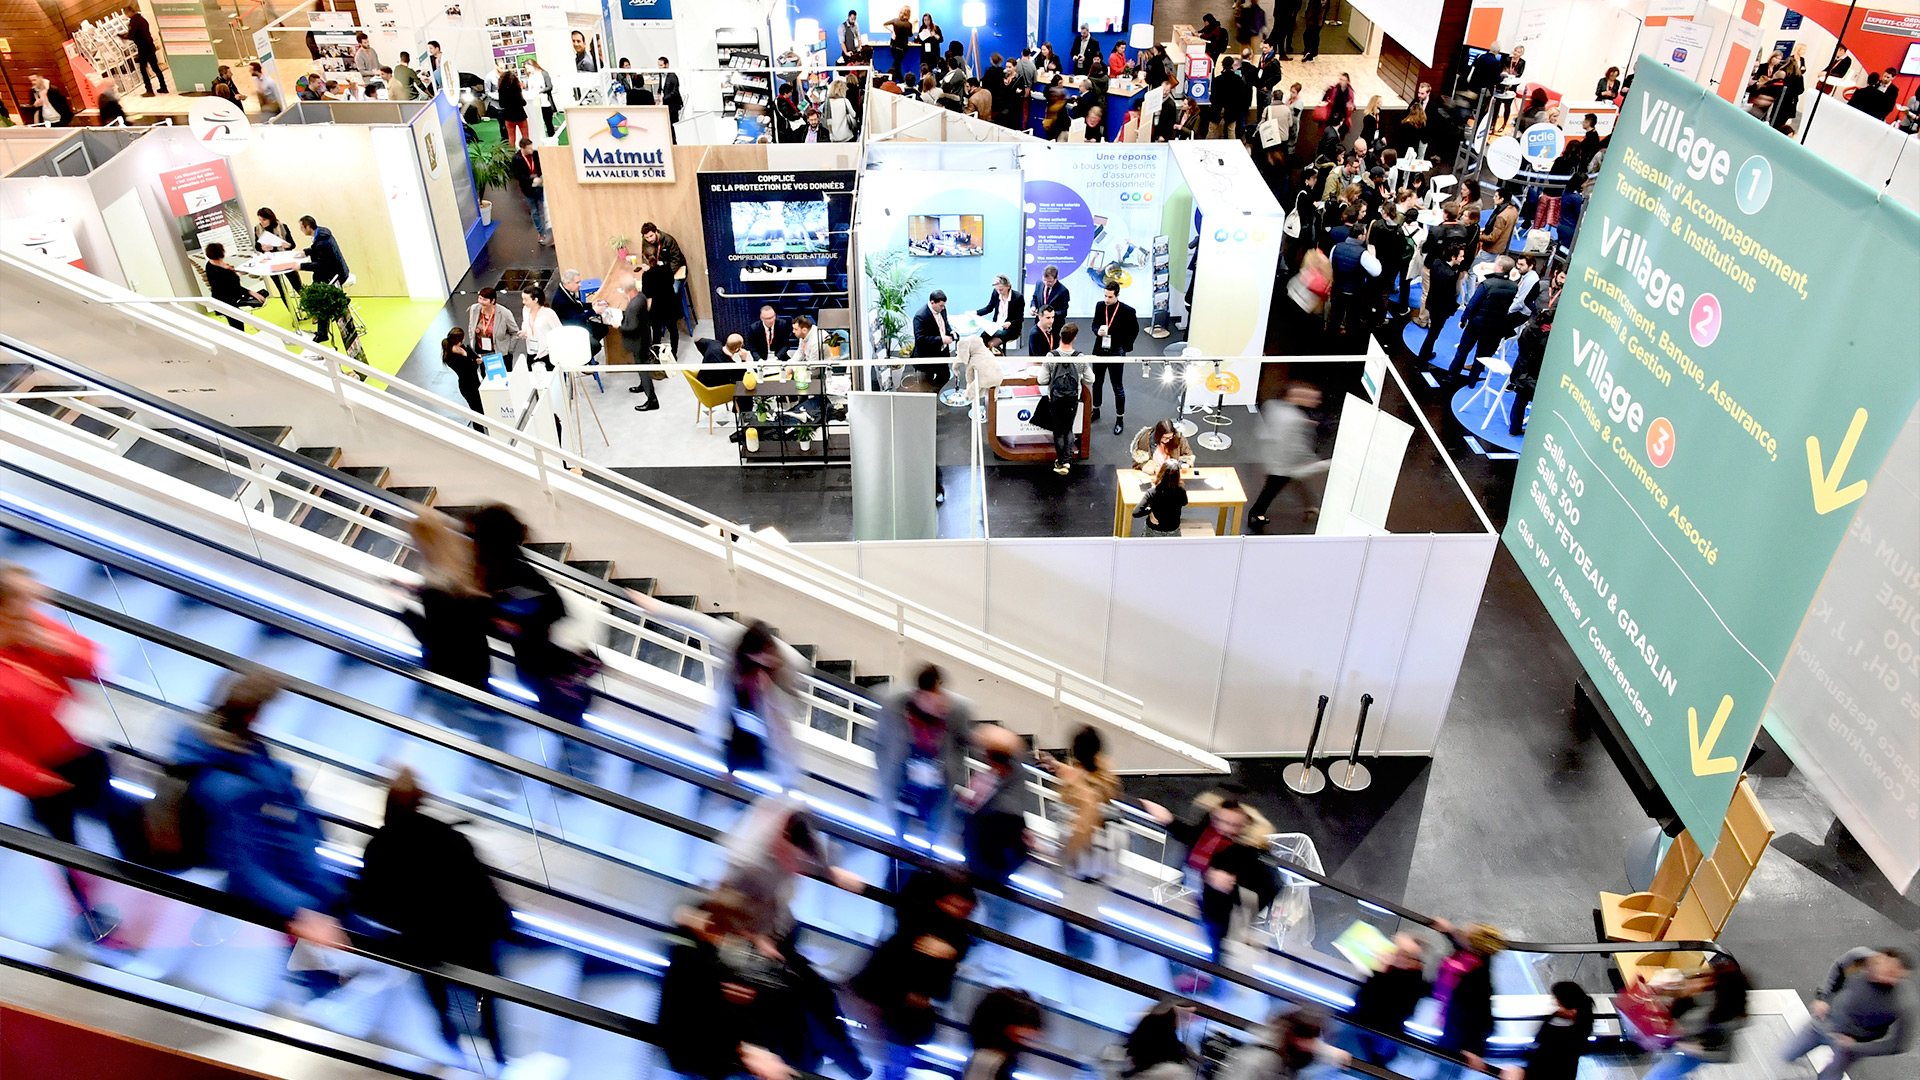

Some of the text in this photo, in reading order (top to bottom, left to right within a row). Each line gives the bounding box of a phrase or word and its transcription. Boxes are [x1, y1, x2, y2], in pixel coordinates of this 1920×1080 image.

[1867, 17, 1920, 29] EXPERTS-COMPT
[583, 148, 664, 164] Matmut
[1118, 153, 1157, 162] réponse
[1528, 132, 1554, 142] adie
[1638, 91, 1762, 200] Village 1
[586, 168, 666, 178] MA VALEUR SÛRE
[723, 184, 734, 192] LA
[810, 181, 844, 190] DONNÉES
[758, 174, 795, 182] COMPLICE
[1072, 162, 1078, 170] à
[1122, 162, 1156, 170] besoins
[1086, 180, 1155, 188] professionnelle
[1102, 171, 1156, 179] d'assurance
[1622, 146, 1673, 192] Réseaux
[786, 252, 838, 260] CYBER-ATTAQUE
[1616, 173, 1757, 294] Territoires & Institutions
[1600, 216, 1713, 336] Village 2
[1580, 291, 1672, 387] Conseil & Gestion
[1584, 266, 1778, 462] Financement, Banque, Assurance,
[1572, 328, 1670, 456] Village 3
[1543, 433, 1585, 498] Salle 150
[1560, 374, 1719, 565] Franchise & Commerce Associé
[1537, 457, 1580, 526] Salle 300
[1530, 480, 1678, 696] Salles FEYDEAU & GRASLIN
[1518, 518, 1654, 727] Club VIP / Presse / Conférenciers
